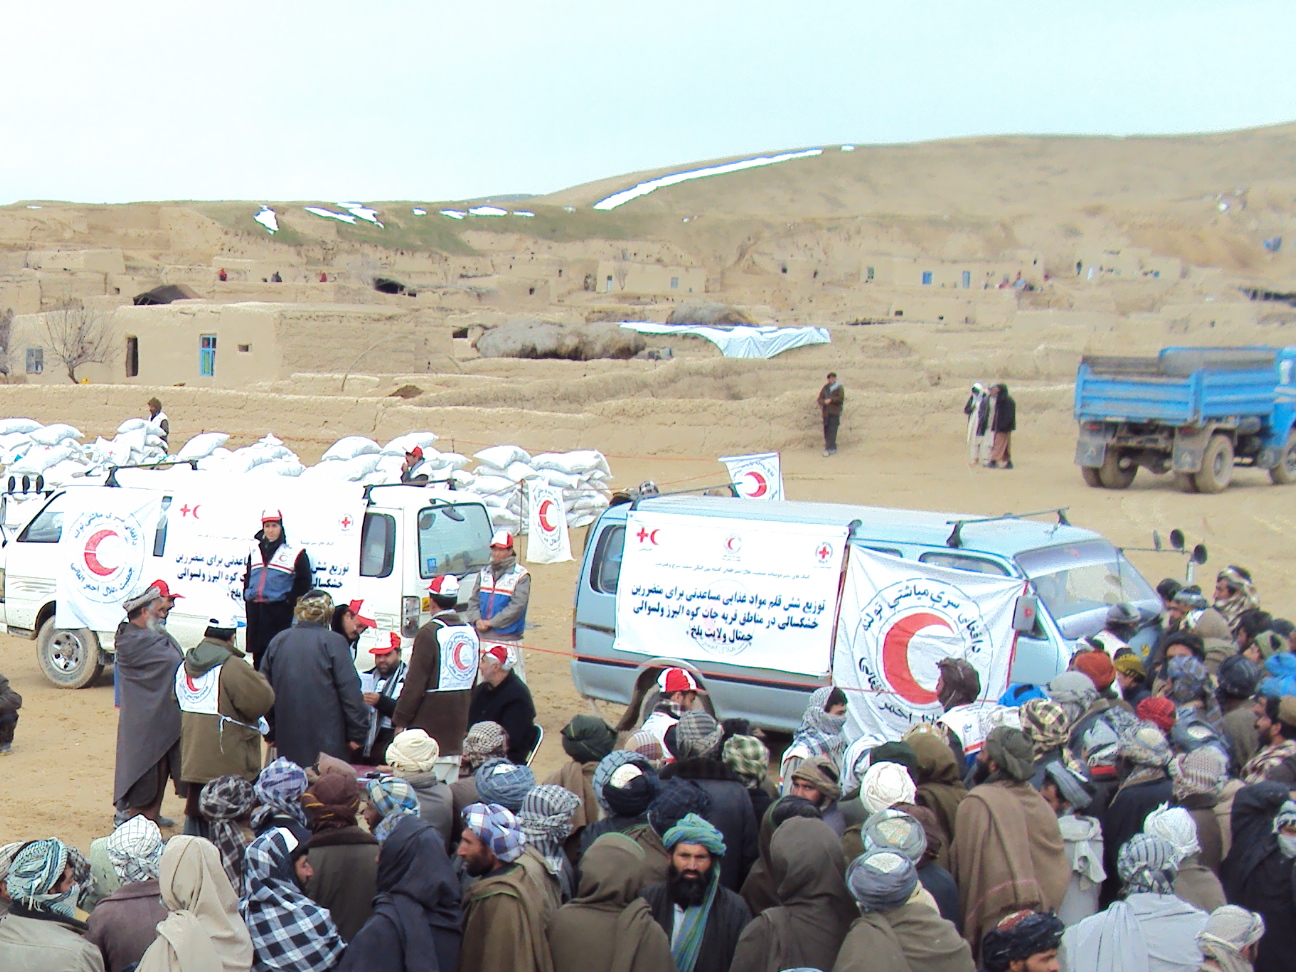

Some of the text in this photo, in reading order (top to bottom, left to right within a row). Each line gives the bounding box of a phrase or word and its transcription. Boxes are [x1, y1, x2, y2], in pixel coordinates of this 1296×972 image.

[176, 552, 204, 565] متضررین
[207, 554, 224, 567] برای
[329, 563, 350, 576] توزیع
[207, 570, 223, 583] البرز
[225, 572, 238, 585] کوه
[312, 577, 343, 588] خشکسال
[632, 583, 826, 615] توزیع شش قلم مواد غذایی مساعدتی برای متضررین
[633, 600, 819, 630] خشکسالی در مناطق قریه جات کوه البرز ولسوالی
[705, 626, 726, 643] ولایت
[878, 702, 913, 723] احمر
